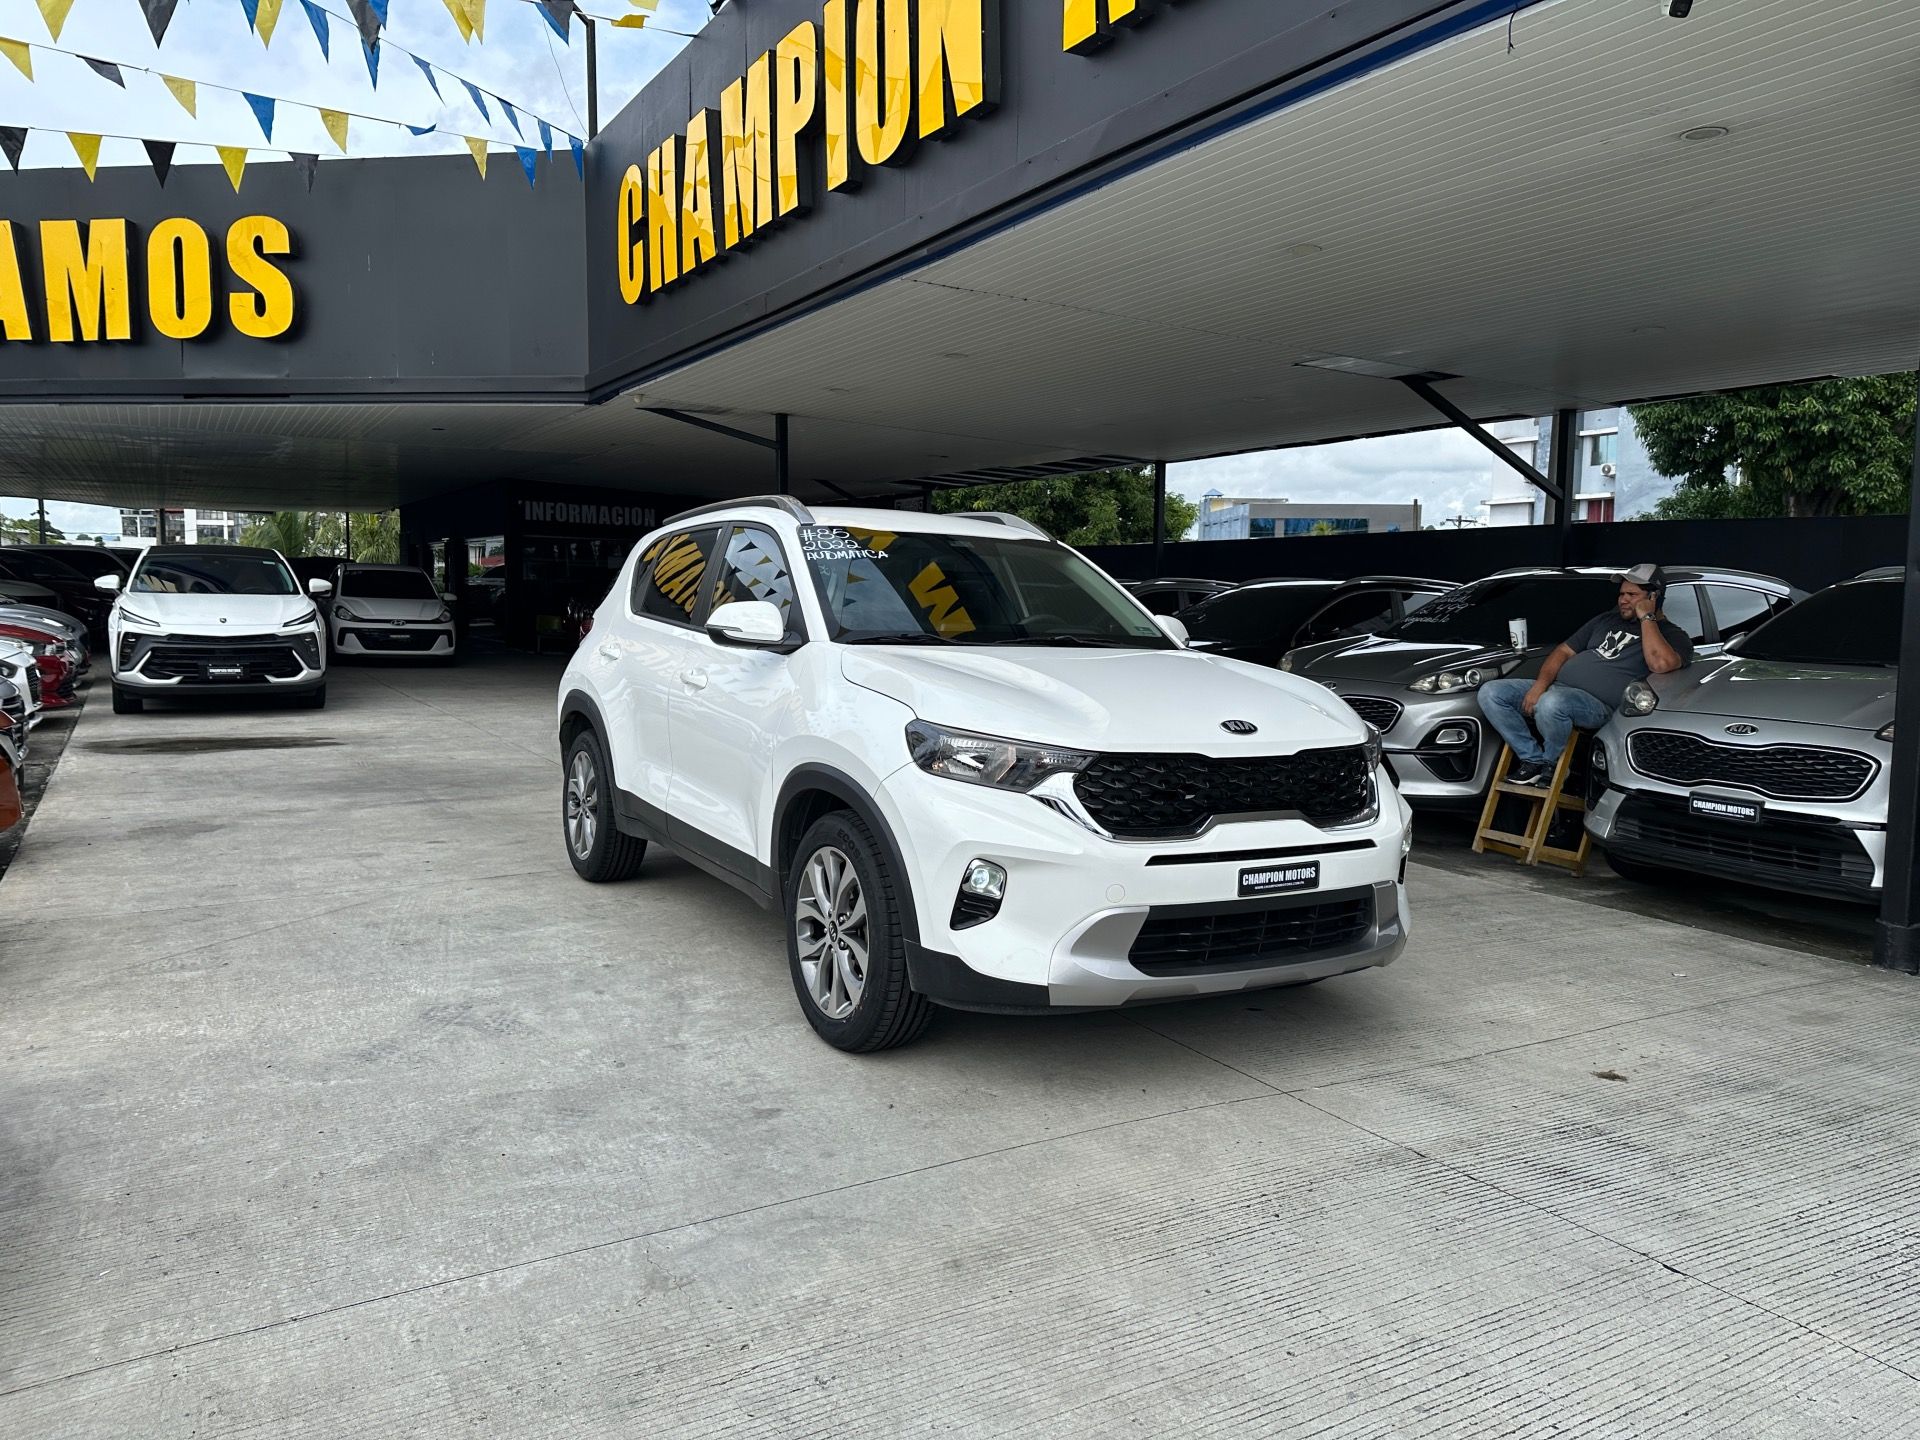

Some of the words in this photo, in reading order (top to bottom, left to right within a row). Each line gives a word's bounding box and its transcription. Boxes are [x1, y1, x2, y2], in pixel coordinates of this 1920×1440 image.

[618, 0, 983, 304] CHAMPION
[524, 500, 656, 527] INFORMACION
[800, 528, 850, 541] #85
[803, 539, 862, 550] 2022
[1729, 725, 1752, 734] KIA
[1693, 800, 1727, 812] CHAMPION
[1727, 805, 1755, 816] MOTORS
[1242, 871, 1284, 886] CHAMPION
[1285, 867, 1316, 881] MOTORS
